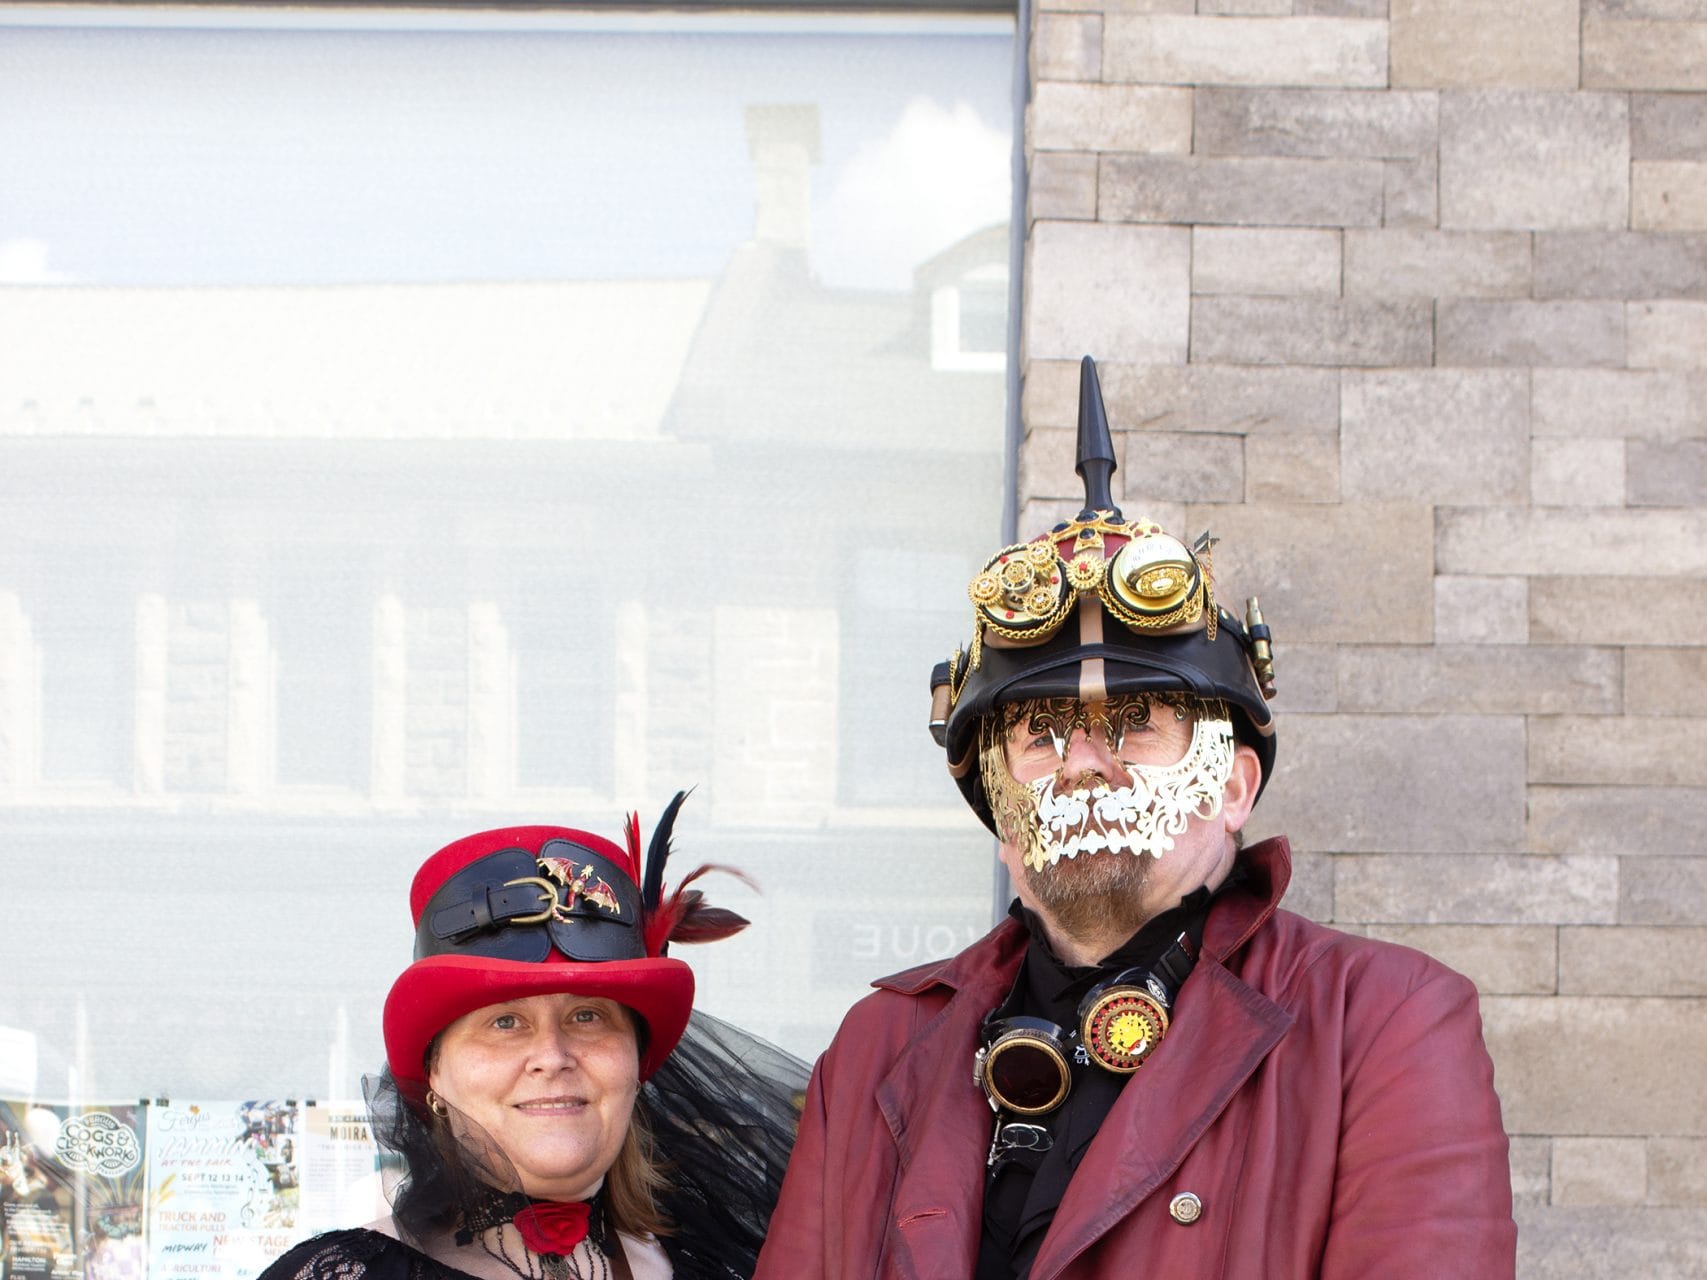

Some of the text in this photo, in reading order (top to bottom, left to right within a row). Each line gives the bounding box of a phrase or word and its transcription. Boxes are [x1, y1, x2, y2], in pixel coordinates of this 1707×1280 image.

[66, 1124, 129, 1146] COGS &
[330, 1127, 368, 1140] MOIRA
[56, 1136, 135, 1161] CLOCKWORK
[182, 1173, 244, 1182] SEPT 12 13 14
[159, 1211, 226, 1223] TRUCK AND
[159, 1224, 225, 1232] TRACTOR PULLS
[162, 1243, 208, 1252] MIDWAY
